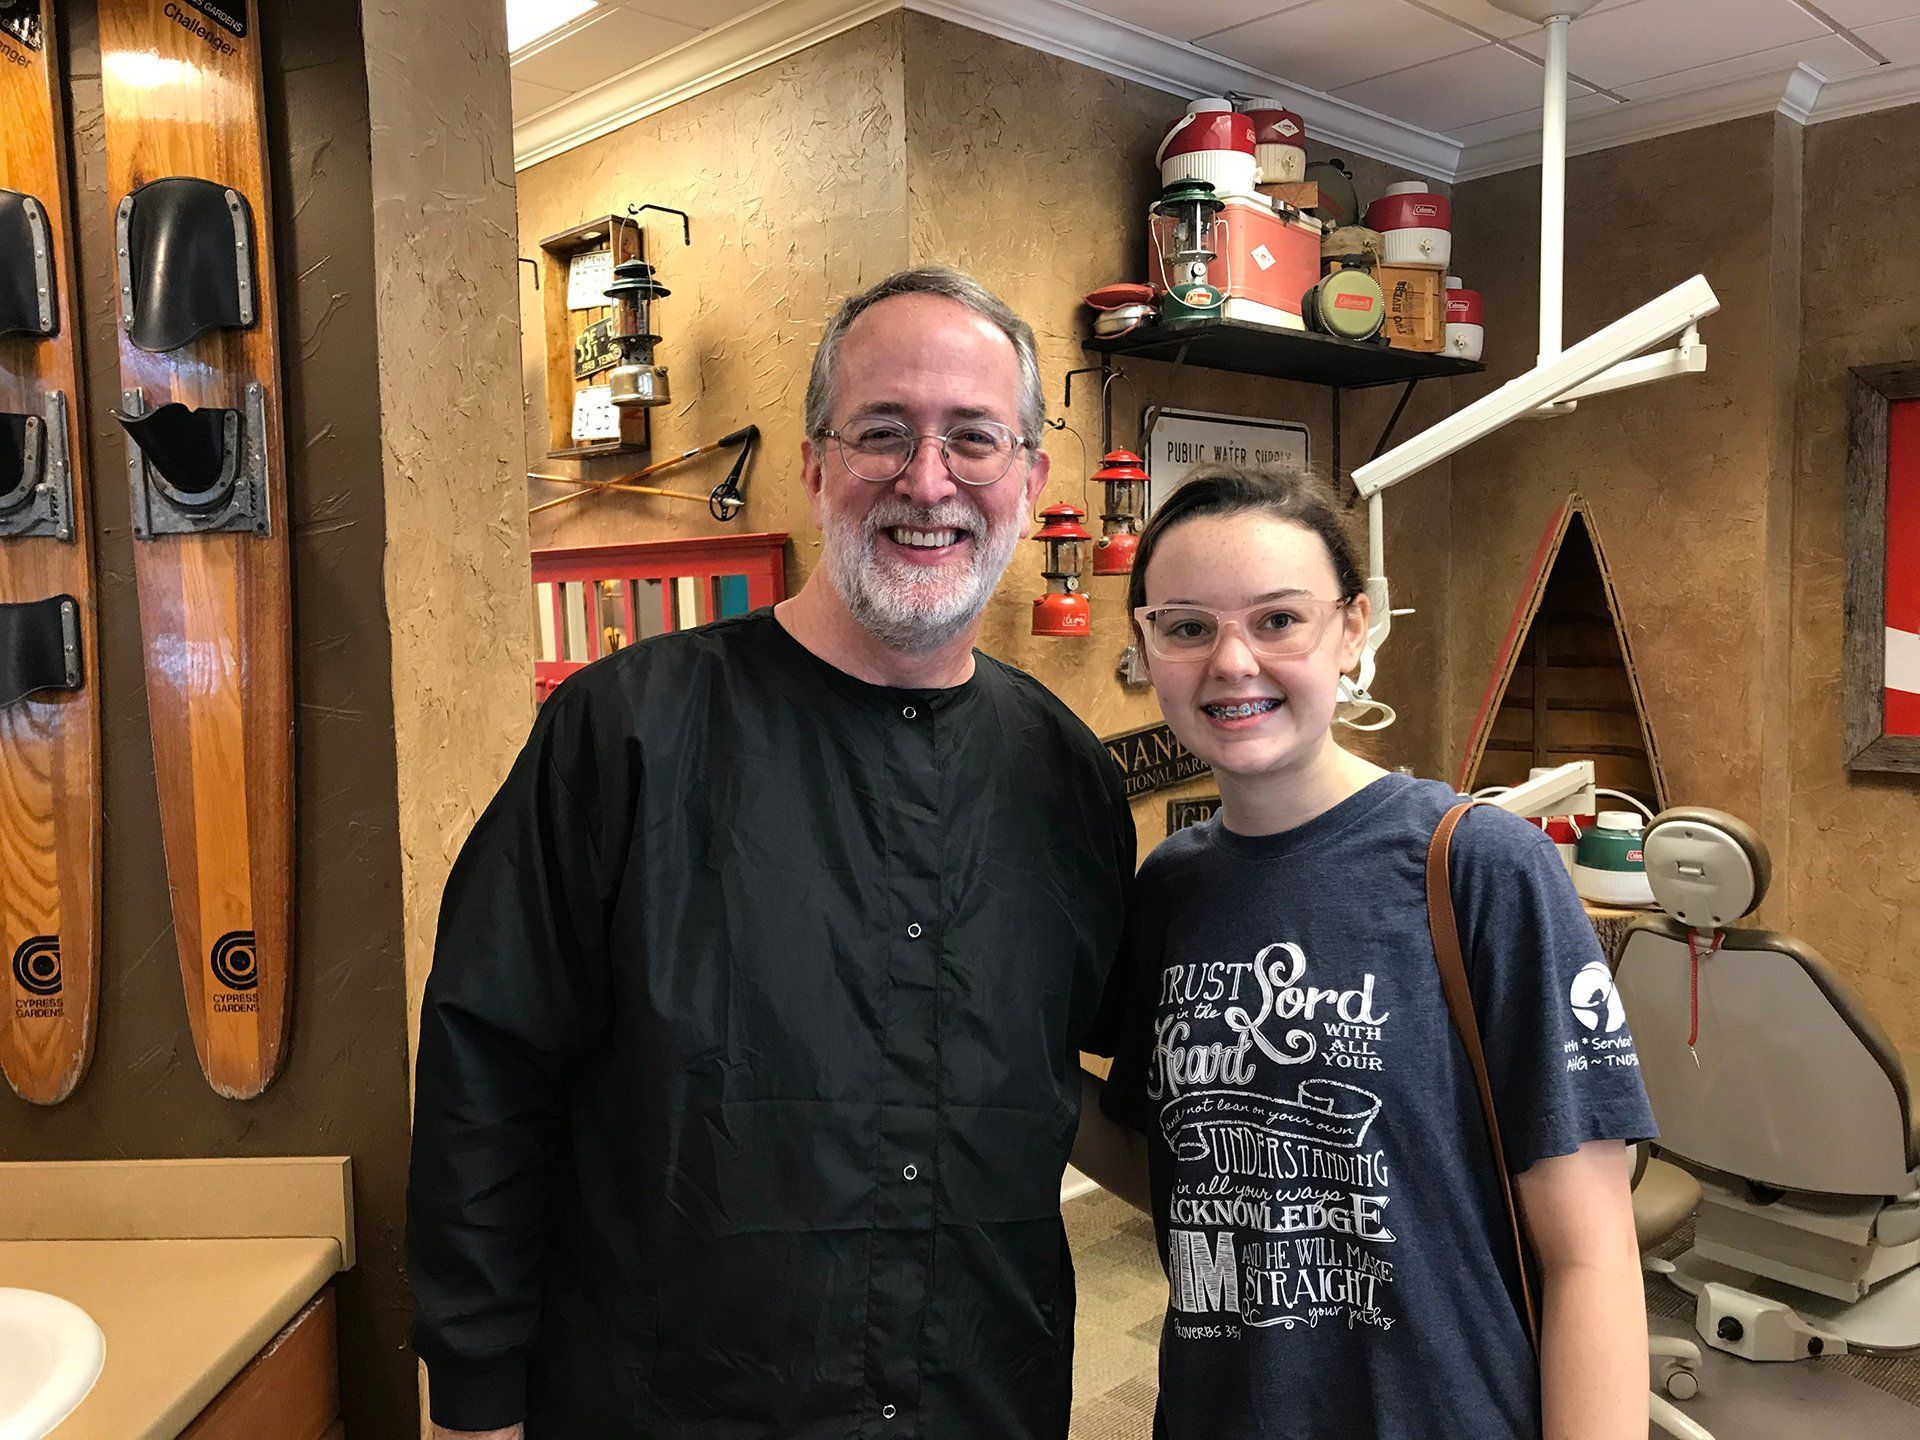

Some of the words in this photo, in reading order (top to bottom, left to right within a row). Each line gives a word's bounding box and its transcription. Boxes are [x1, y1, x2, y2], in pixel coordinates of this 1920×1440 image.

[164, 3, 237, 56] Challenger
[1167, 441, 1205, 464] PUBLIC
[1213, 445, 1247, 466] WATER
[1159, 961, 1253, 1006] TRUST
[15, 998, 64, 1008] CYPRESS
[213, 993, 260, 1003] CYPRESS
[213, 1003, 260, 1013] GARDENS
[1177, 1008, 1189, 1019] in
[1194, 1002, 1222, 1019] the
[1224, 942, 1389, 1065] Lord
[16, 1008, 64, 1018] GARDENS
[1323, 1022, 1383, 1041] WITH
[1147, 1014, 1257, 1100] Heart
[1331, 1040, 1378, 1056] ALL
[1321, 1052, 1385, 1072] YOUR
[1185, 1098, 1214, 1114] not
[1217, 1096, 1249, 1113] lean
[1252, 1107, 1265, 1116] on
[1268, 1110, 1314, 1125] your
[1316, 1119, 1355, 1135] own
[1210, 1127, 1389, 1187] UNDERSTANDING
[1177, 1179, 1192, 1194] in
[1196, 1175, 1233, 1195] all
[1233, 1184, 1273, 1203] your
[1275, 1186, 1345, 1213] ways
[1242, 1243, 1262, 1266] AND
[1266, 1240, 1291, 1269] HE
[1295, 1237, 1342, 1267] WILL
[1347, 1242, 1393, 1283] MAKE
[1245, 1266, 1383, 1309] STRAIGHT
[1308, 1306, 1343, 1328] your
[1349, 1306, 1396, 1330] paths
